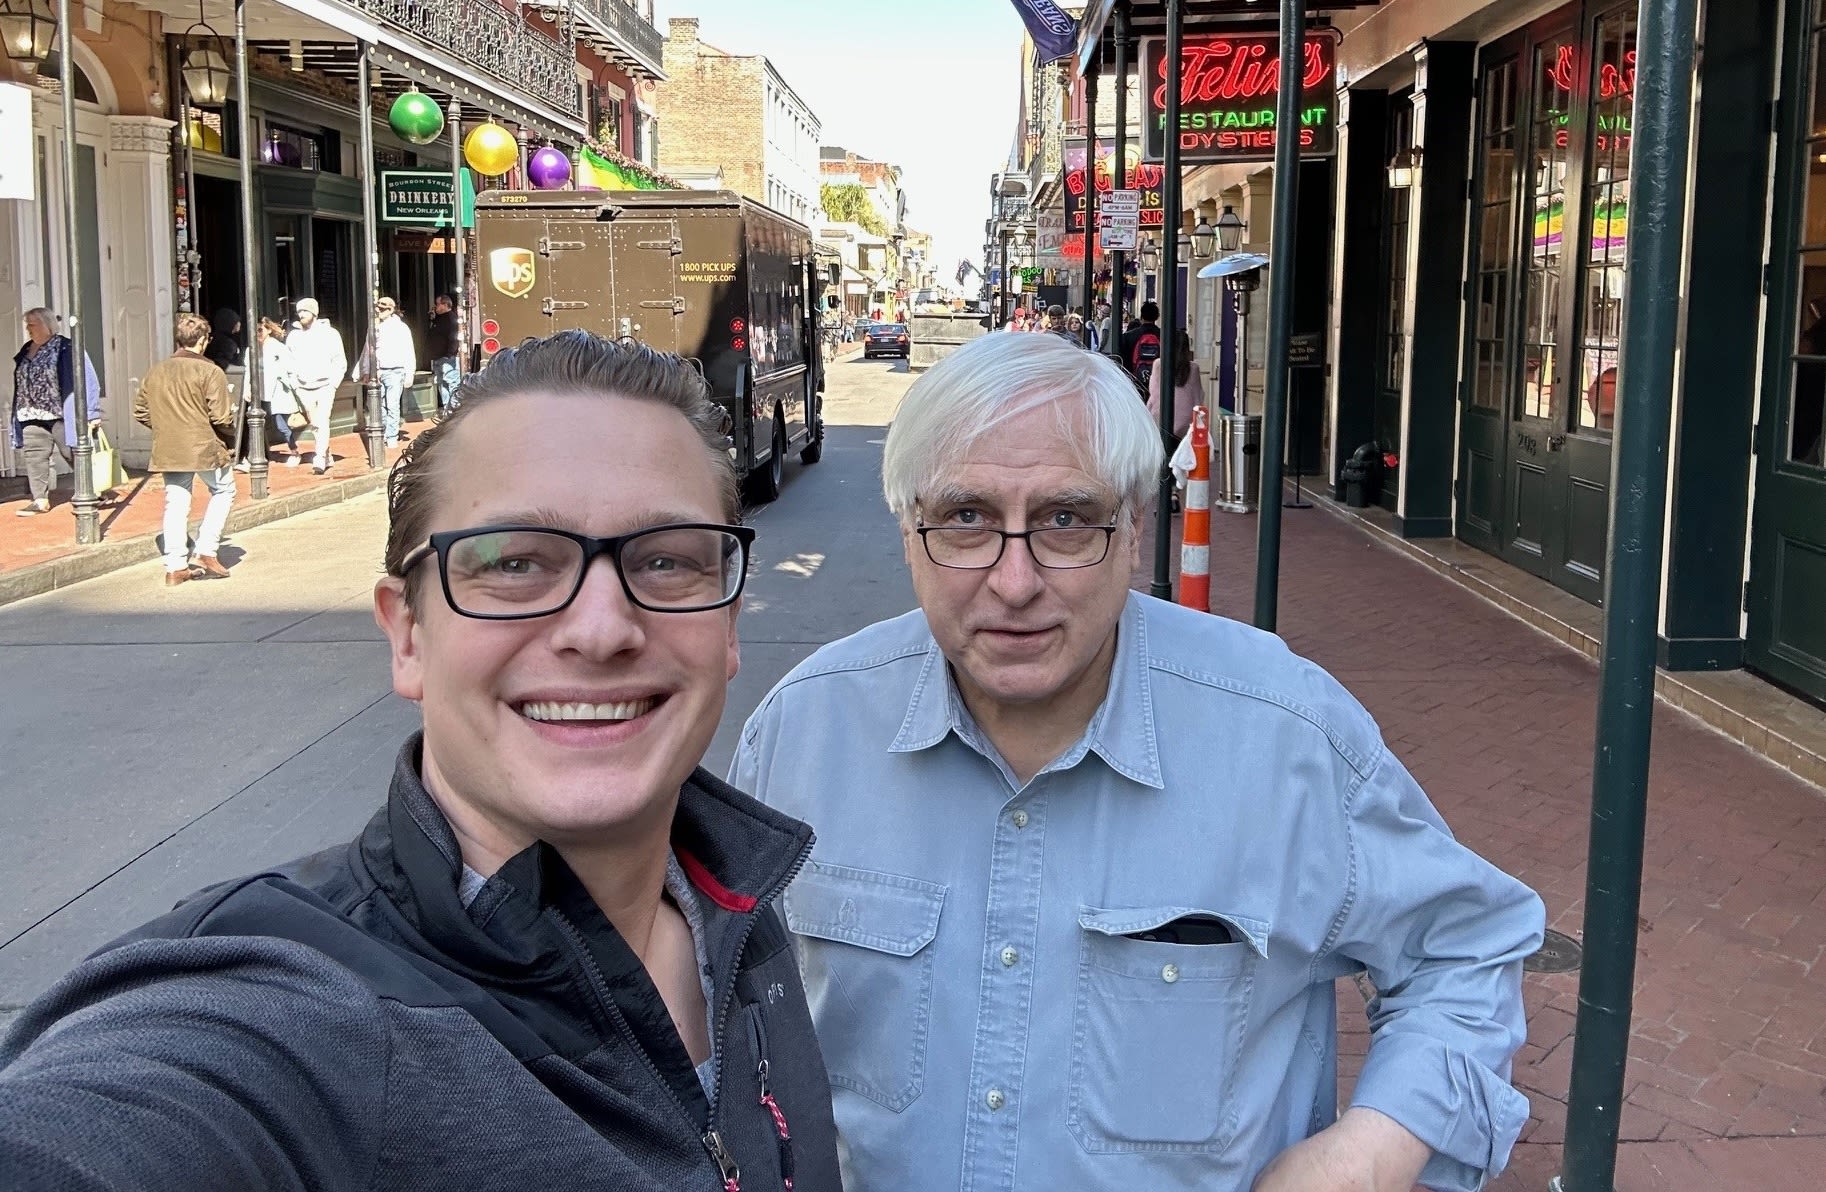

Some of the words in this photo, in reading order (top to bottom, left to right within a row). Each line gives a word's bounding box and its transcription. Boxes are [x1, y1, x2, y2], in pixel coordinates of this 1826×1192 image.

[1158, 108, 1327, 130] RESTAURNT
[1179, 129, 1315, 150] OYSTES
[427, 179, 454, 189] STREE
[1066, 166, 1112, 195] BG
[389, 191, 455, 205] DRINKERY
[1102, 193, 1113, 202] NO
[1101, 218, 1112, 226] NO
[1141, 210, 1164, 224] SLIC
[680, 263, 700, 271] 1800
[701, 263, 720, 271] PICK
[721, 263, 736, 271] UPS
[680, 274, 737, 283] www.ups.com
